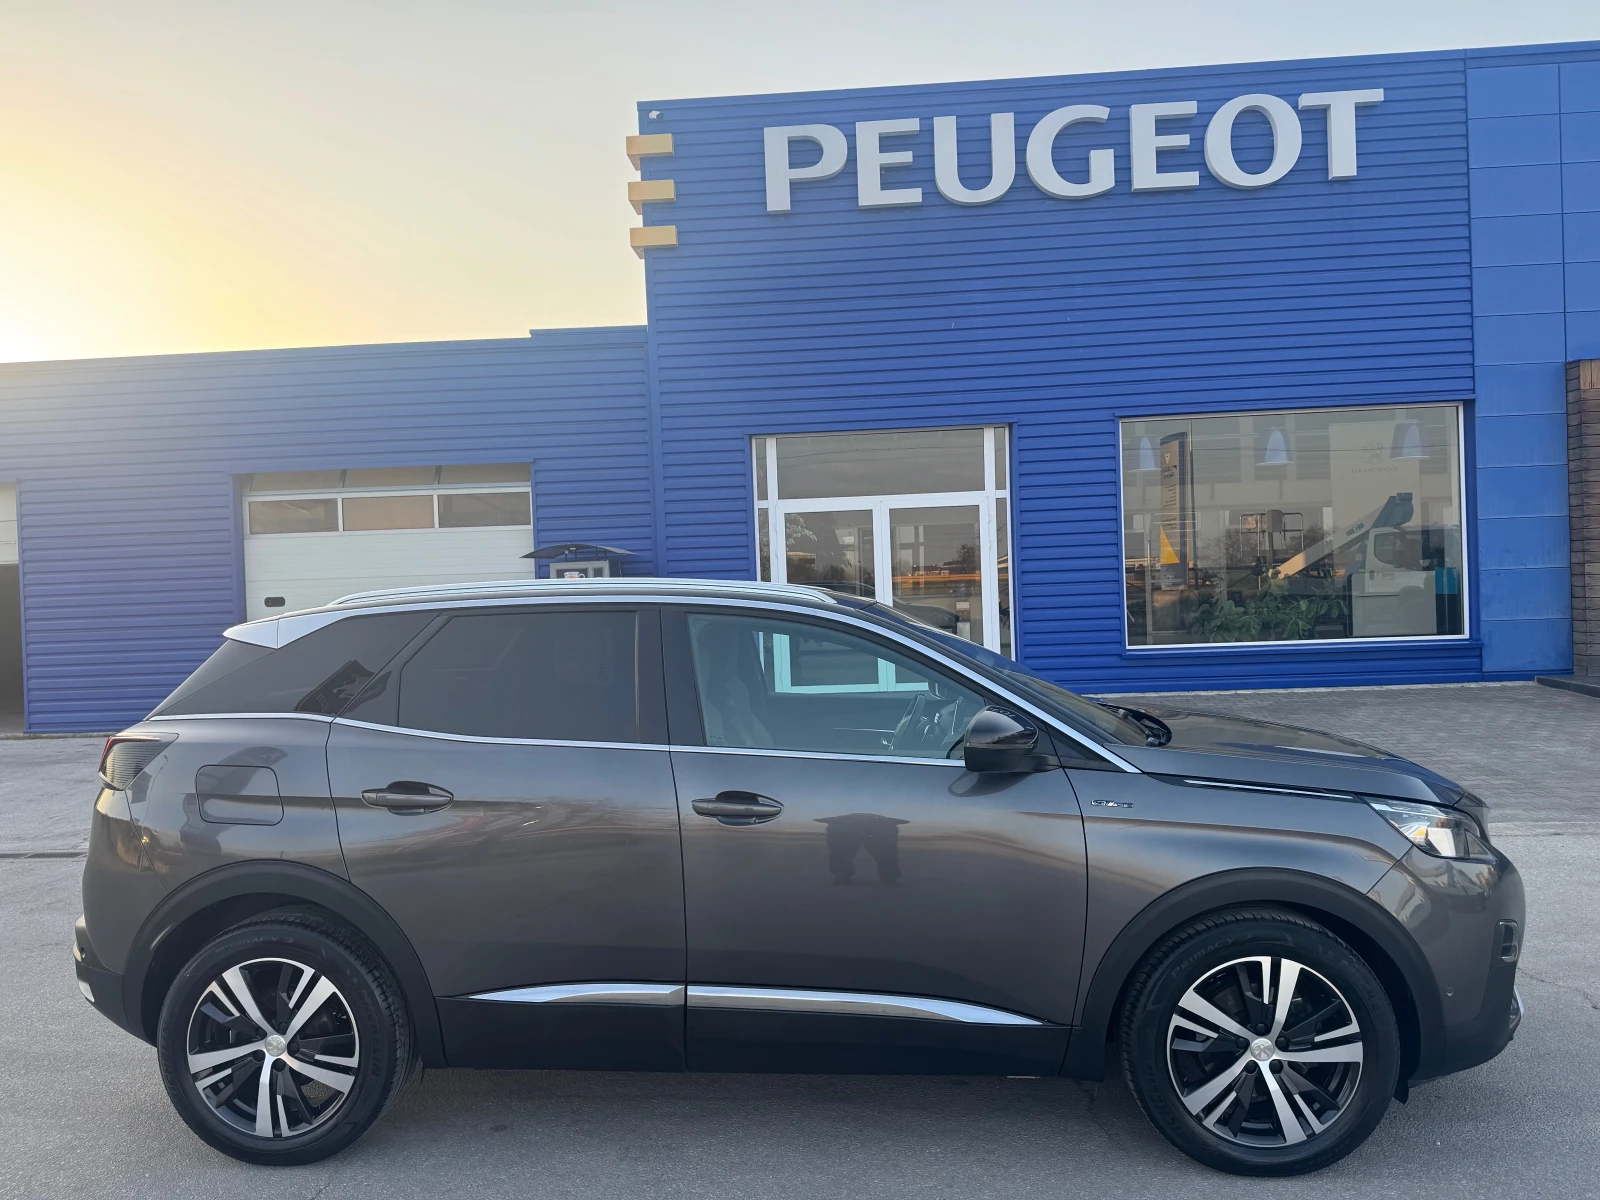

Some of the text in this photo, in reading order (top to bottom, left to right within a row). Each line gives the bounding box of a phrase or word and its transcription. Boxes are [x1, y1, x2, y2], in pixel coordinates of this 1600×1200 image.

[763, 88, 1385, 213] PEUGEOT
[1171, 932, 1252, 978] PRIMACY 3
